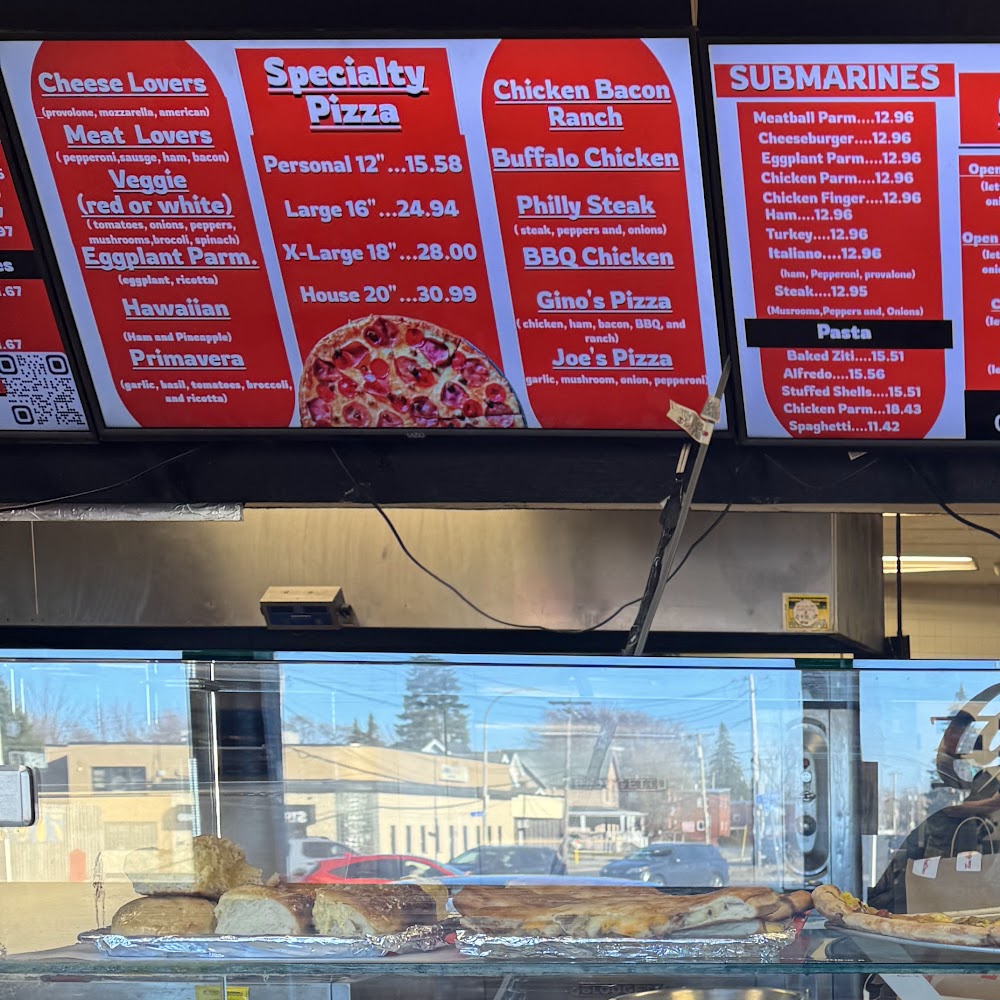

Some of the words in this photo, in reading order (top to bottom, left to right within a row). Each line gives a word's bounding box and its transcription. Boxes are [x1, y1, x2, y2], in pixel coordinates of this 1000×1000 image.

[38, 73, 123, 93] Cheese
[128, 72, 206, 93] Lovers
[264, 56, 425, 95] Specialty
[730, 65, 939, 91] SUBMARINES
[493, 79, 589, 100] Chicken
[595, 79, 670, 99] Bacon
[42, 108, 97, 118] (provolone,
[100, 108, 158, 118] mozzarella,
[159, 108, 209, 117] american)
[306, 94, 399, 124] Pizza
[548, 106, 622, 126] Ranch
[753, 111, 814, 124] Meatball
[64, 125, 125, 145] Meat
[135, 125, 212, 144] Lovers
[162, 152, 190, 163] ham,
[193, 152, 229, 163] bacon)
[263, 155, 352, 173] Personal
[491, 146, 579, 168] Buffalo
[584, 146, 679, 167] Chicken
[762, 152, 823, 167] Eggplant
[109, 169, 186, 195] Veggie
[761, 172, 816, 184] Chicken
[78, 193, 123, 215] (red
[129, 201, 151, 214] or
[158, 193, 231, 215] white)
[763, 191, 818, 204] Chicken
[284, 200, 342, 222] Large
[517, 195, 581, 220] Philly
[587, 195, 655, 214] Steak
[149, 220, 187, 231] onions,
[190, 221, 235, 232] peppers,
[557, 226, 599, 237] peppers
[602, 225, 625, 236] and,
[628, 224, 666, 235] onions)
[195, 235, 239, 246] spinach)
[962, 232, 998, 247] Open
[82, 247, 184, 270] Eggplant
[188, 247, 257, 266] Parm.
[282, 243, 363, 265] X-Large
[523, 247, 578, 267] BBQ
[582, 246, 674, 266] Chicken
[118, 275, 173, 286] (eggplant,
[176, 275, 218, 285] ricotta)
[780, 269, 808, 279] (ham,
[811, 270, 862, 280] Pepperoni,
[300, 286, 360, 302] House
[537, 289, 605, 310] Gino's
[610, 290, 672, 309] Pizza
[122, 298, 229, 317] Hawaiian
[569, 319, 595, 329] ham,
[598, 319, 633, 329] bacon,
[635, 319, 663, 330] BBQ,
[666, 319, 685, 328] and
[817, 324, 872, 339] Pasta
[123, 332, 152, 342] (Ham
[155, 333, 173, 341] and
[176, 332, 232, 343] Pineapple)
[585, 333, 619, 344] ranch)
[130, 349, 244, 367] Primavera
[552, 347, 607, 366] Joe's
[612, 348, 673, 366] Pizza
[787, 350, 828, 361] Baked
[120, 380, 158, 390] (garlic,
[160, 381, 189, 390] basil,
[191, 381, 244, 390] tomatoes,
[246, 381, 292, 390] broccoli,
[526, 375, 558, 386] garlic,
[561, 375, 618, 386] mushroom,
[620, 375, 652, 386] onion,
[165, 395, 184, 403] and
[187, 394, 227, 403] ricotta)
[782, 386, 830, 397] Stuffed
[784, 403, 835, 414] Chicken
